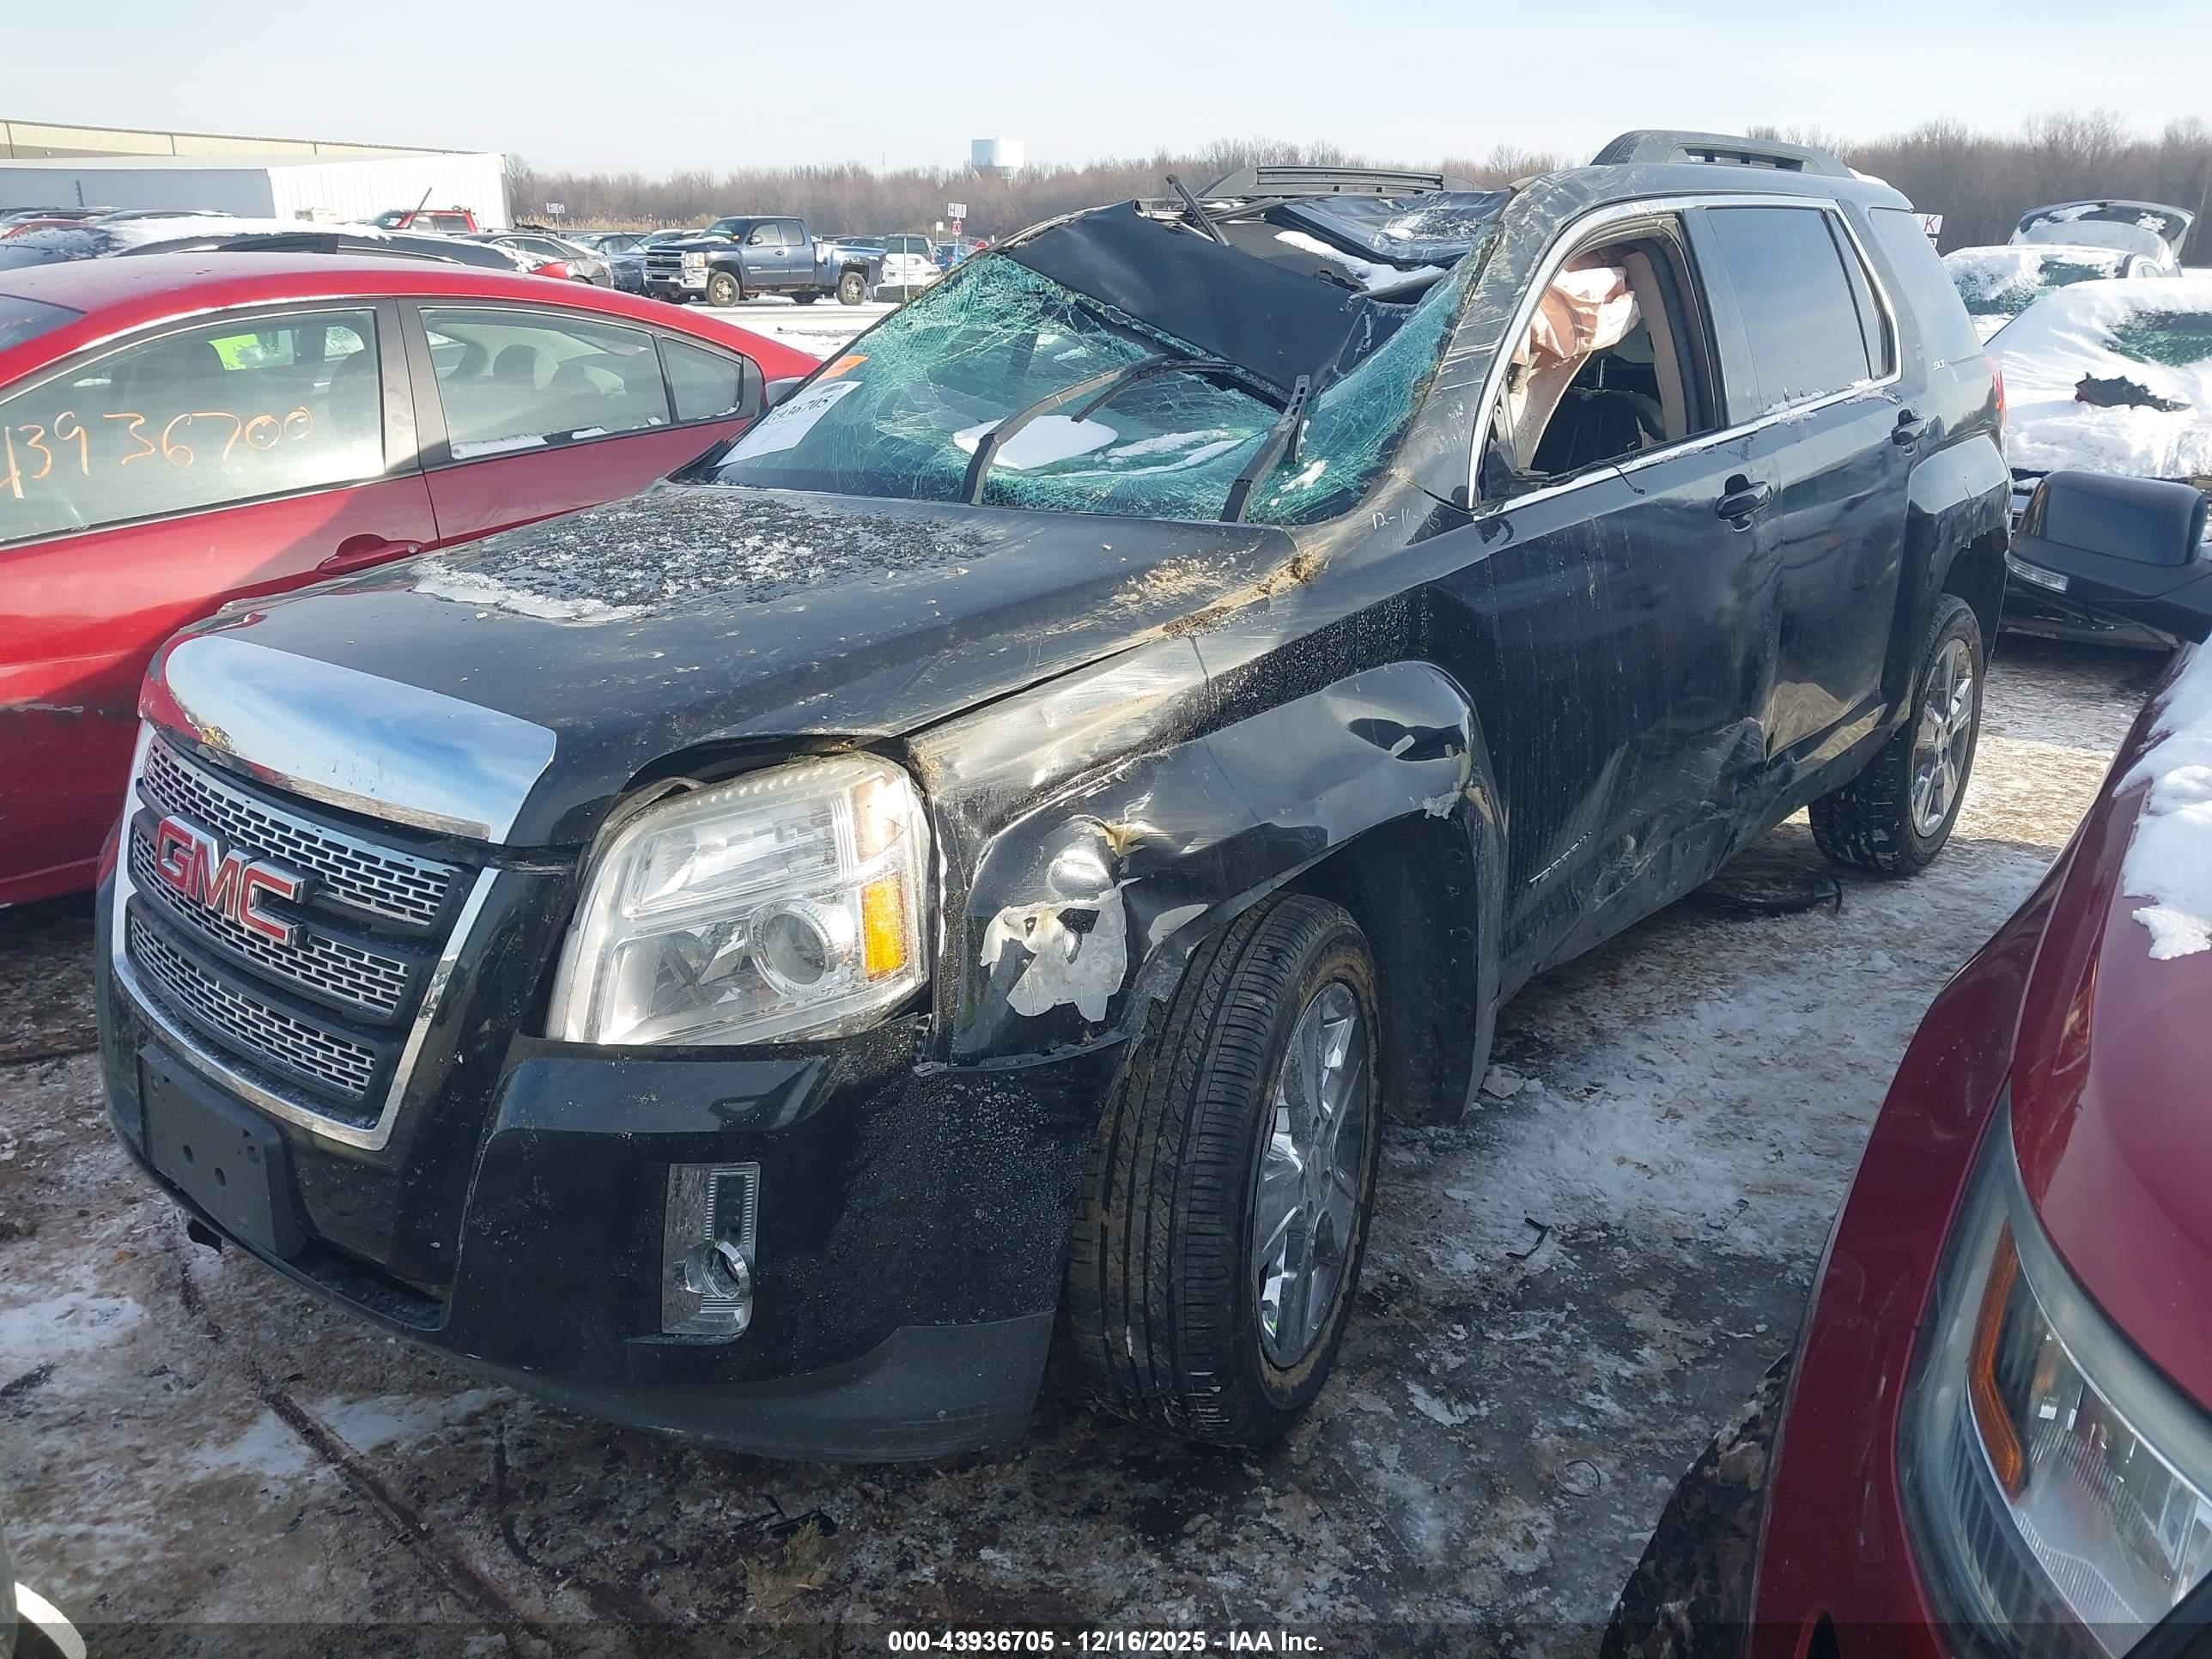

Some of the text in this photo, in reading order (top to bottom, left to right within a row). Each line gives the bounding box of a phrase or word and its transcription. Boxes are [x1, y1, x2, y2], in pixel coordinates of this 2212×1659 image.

[949, 204, 956, 216] H
[1923, 215, 1938, 233] K
[155, 815, 306, 946] GMC
